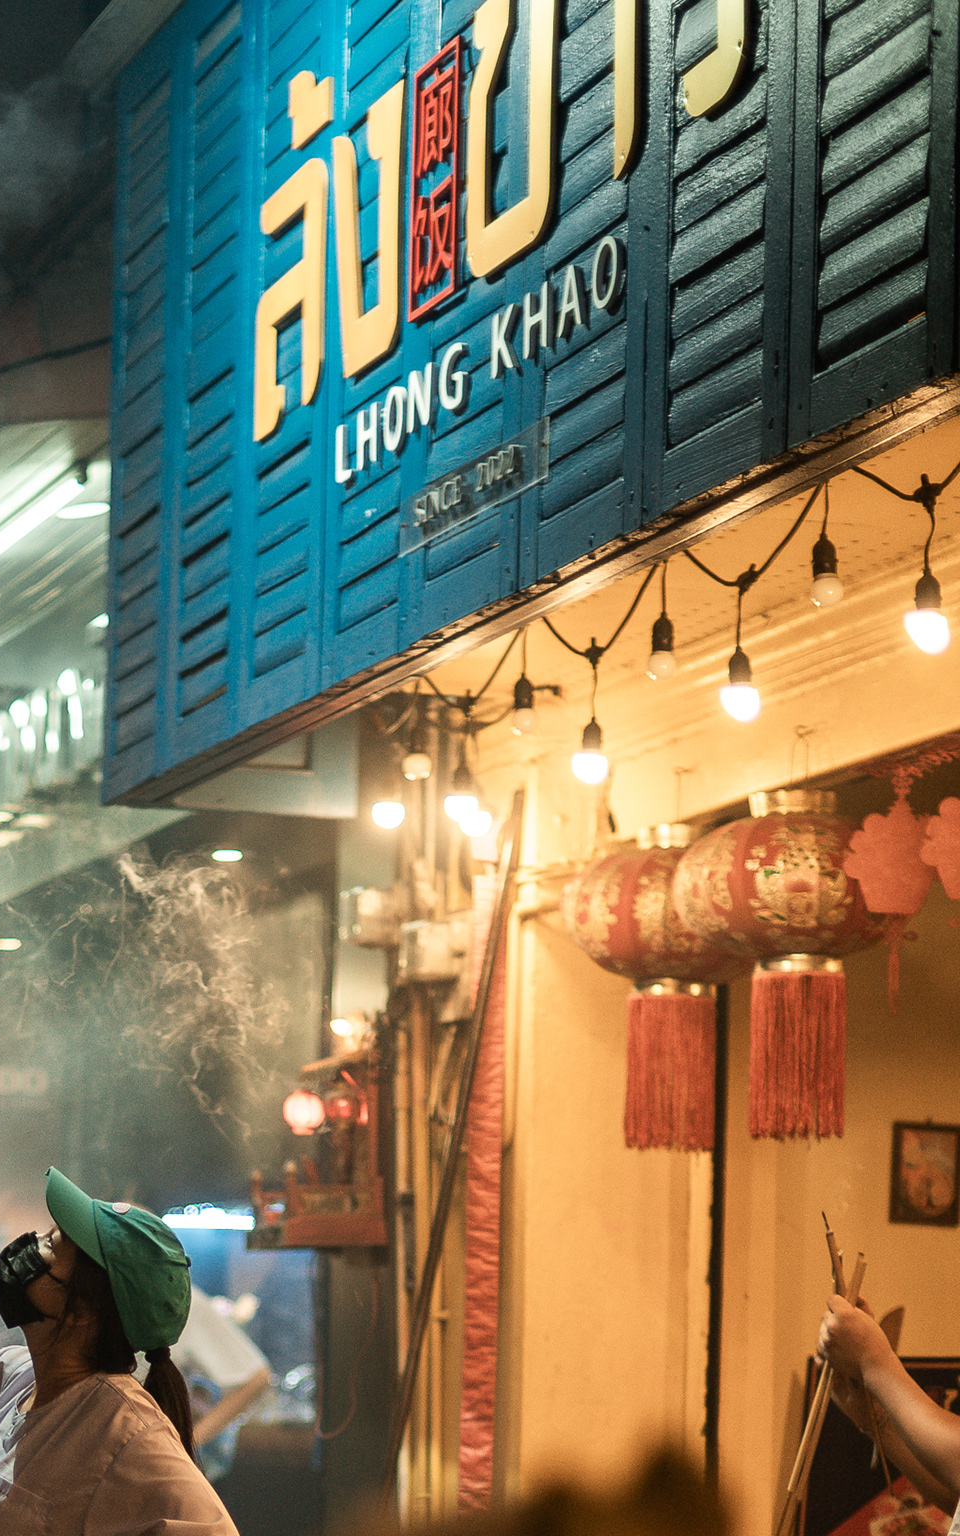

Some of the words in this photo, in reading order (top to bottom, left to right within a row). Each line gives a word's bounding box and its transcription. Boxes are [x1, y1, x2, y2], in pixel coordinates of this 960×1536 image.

[335, 342, 469, 482] LHONG
[491, 236, 618, 380] KHAO
[413, 475, 462, 527] SINCE
[475, 444, 527, 492] 2022
